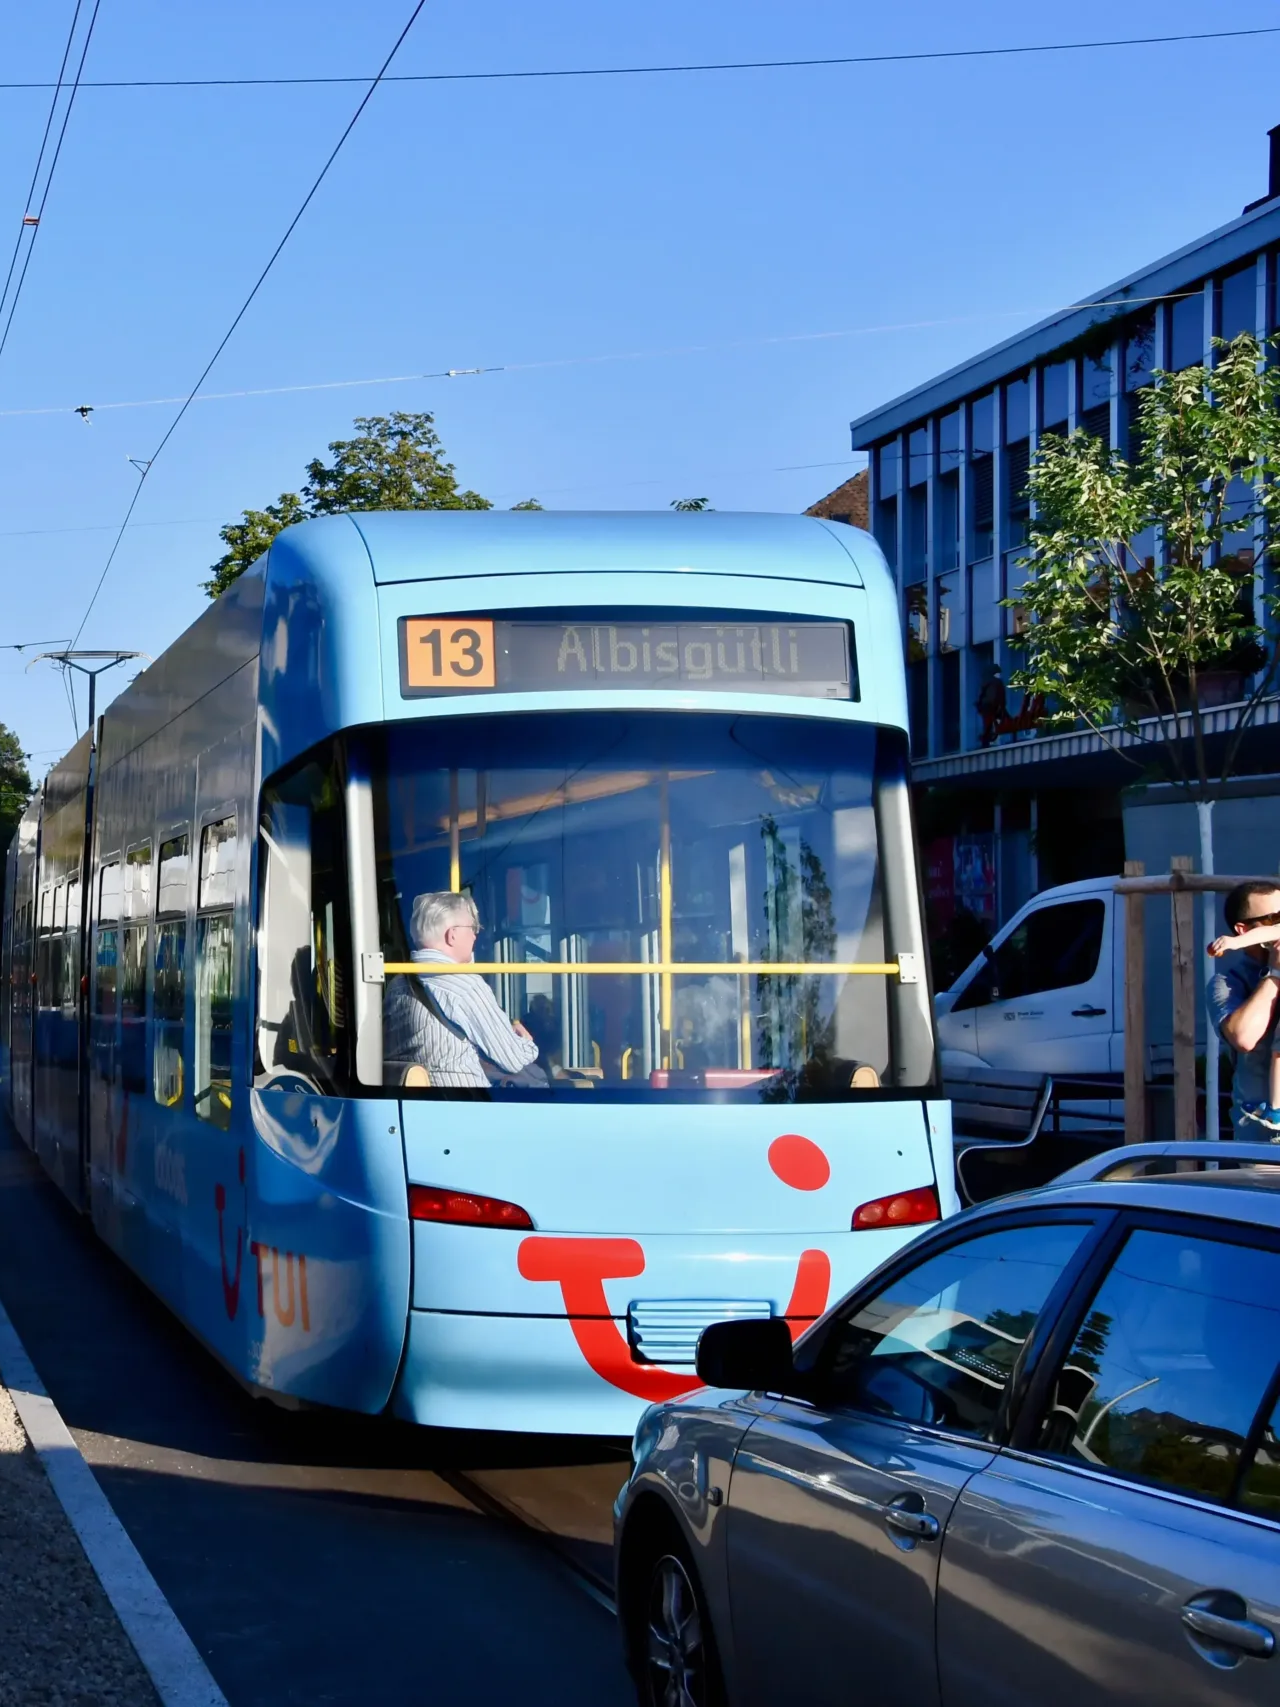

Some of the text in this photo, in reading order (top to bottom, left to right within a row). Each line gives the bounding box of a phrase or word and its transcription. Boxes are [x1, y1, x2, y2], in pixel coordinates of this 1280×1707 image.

[420, 625, 800, 682] 13 Albisgütli
[250, 1241, 310, 1332] TUI
